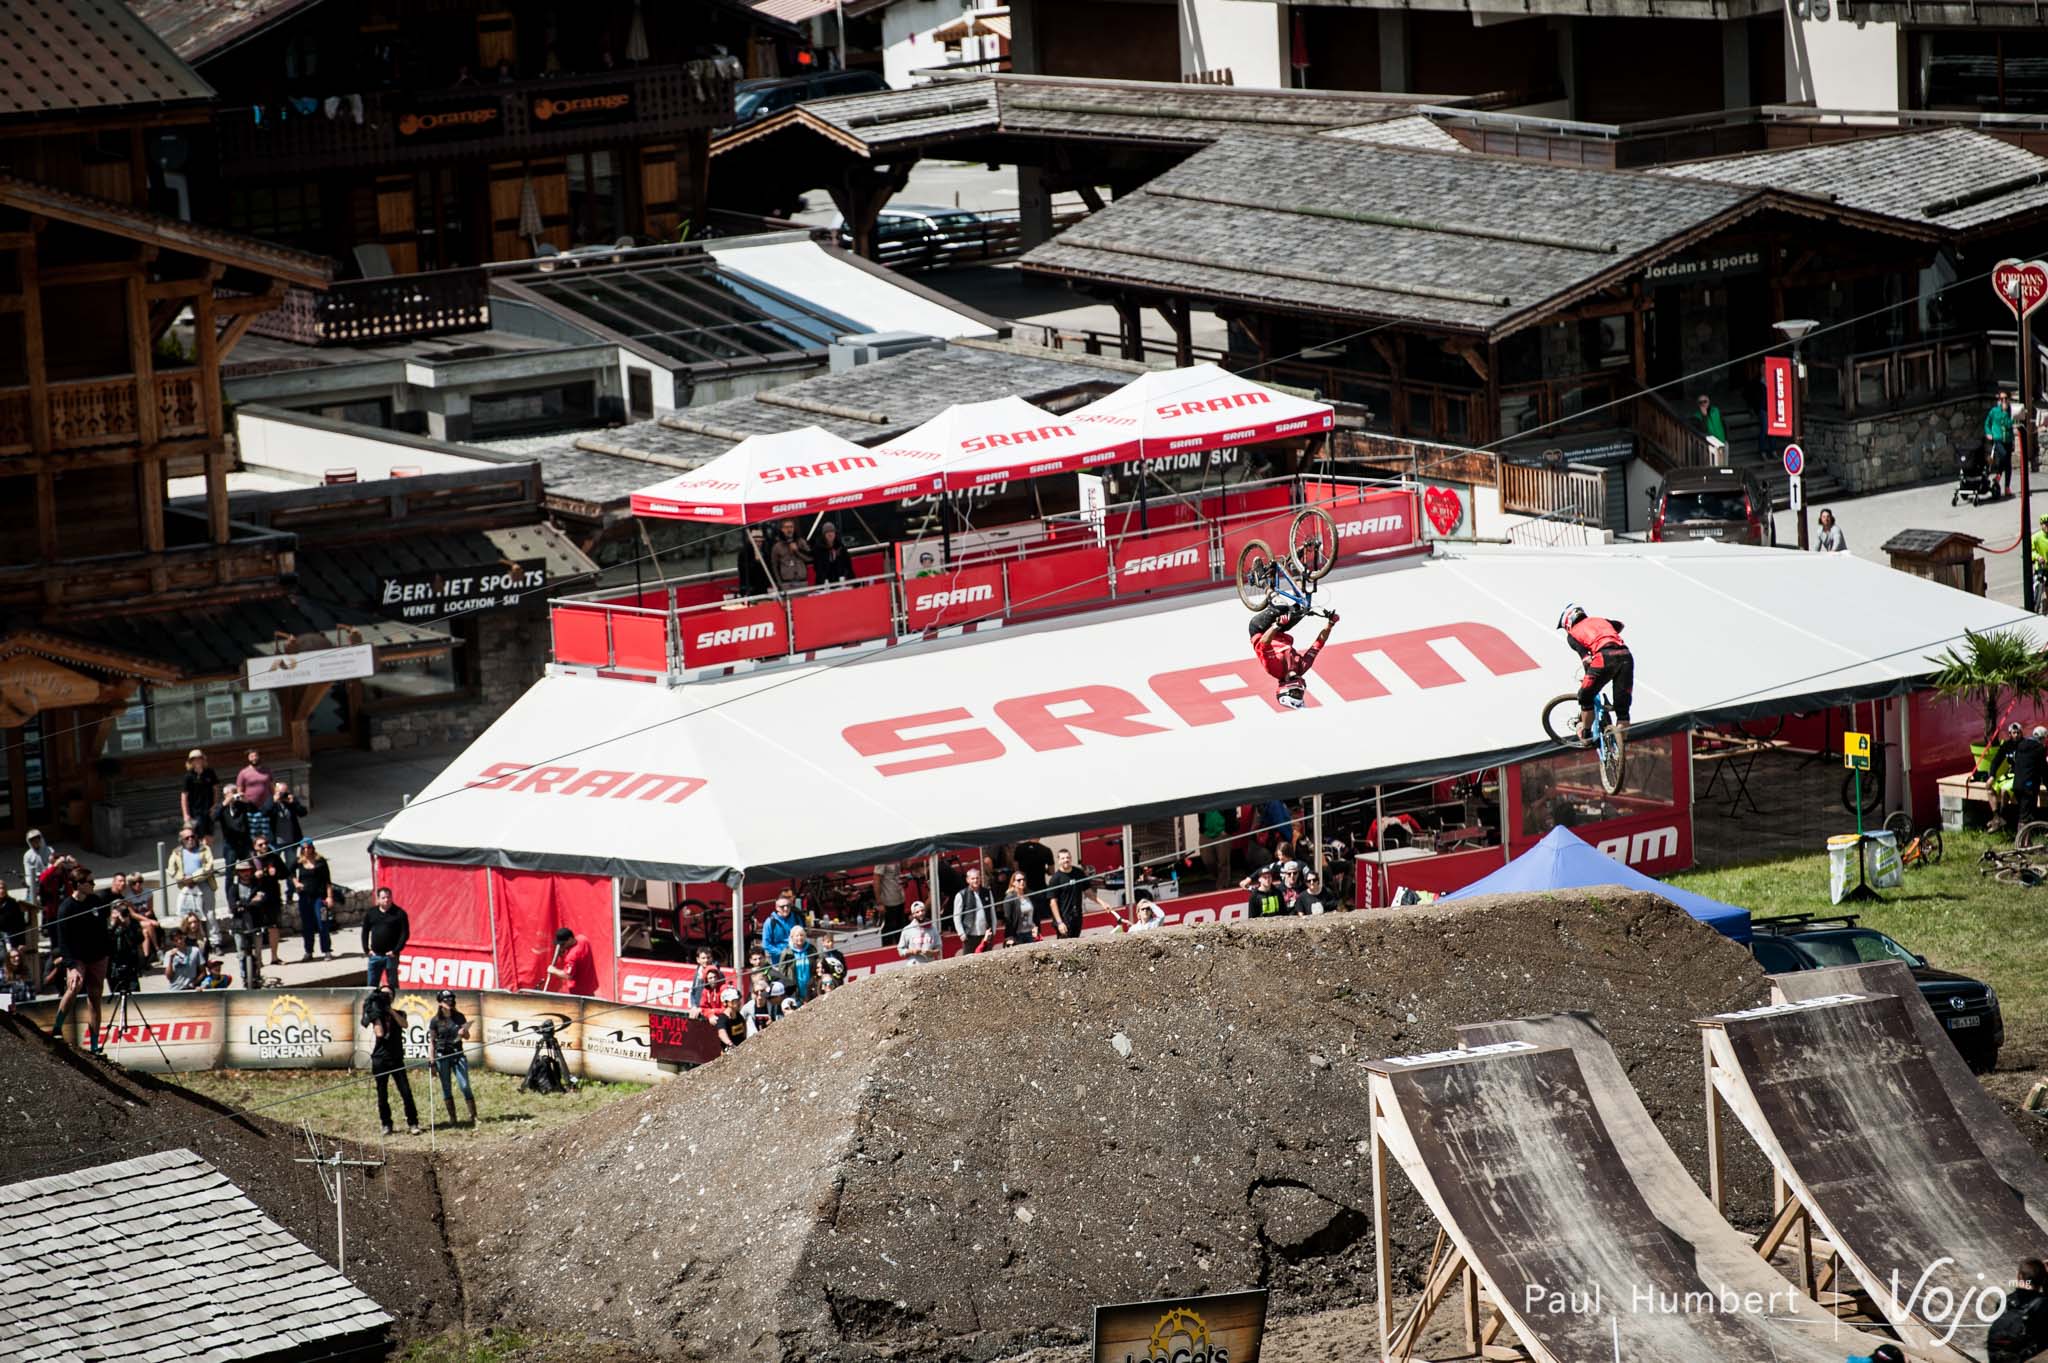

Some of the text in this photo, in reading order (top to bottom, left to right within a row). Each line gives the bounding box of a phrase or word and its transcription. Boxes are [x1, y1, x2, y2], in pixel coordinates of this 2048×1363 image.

[553, 95, 629, 113] Orange
[419, 108, 497, 129] Orange
[1712, 253, 1759, 271] sports
[1156, 391, 1271, 420] SRAM
[1072, 414, 1136, 426] SRAM
[1275, 420, 1308, 432] SRAM
[960, 424, 1076, 453] SRAM
[1169, 438, 1203, 449] SRAM
[1222, 429, 1256, 441] SRAM
[1082, 451, 1116, 464] SRAM
[1210, 447, 1238, 465] SKI
[759, 456, 878, 484] SRAM
[975, 470, 1009, 482] SRAM
[1029, 461, 1062, 474] SRAM
[883, 483, 917, 496] SRAM
[772, 501, 807, 513] SRAM
[828, 493, 863, 505] SRAM
[1124, 548, 1199, 576] SRAM
[403, 594, 520, 617] VENTE LOCATION SKI
[915, 584, 993, 611] SRAM
[696, 621, 775, 650] SRAM
[842, 621, 1541, 777] SRAM
[464, 762, 707, 804] SRAM
[1596, 826, 1678, 864] AM
[621, 974, 694, 1008] SRA
[83, 1021, 212, 1046] SRAM
[249, 1025, 332, 1045] Les Gets
[650, 1030, 682, 1046] +0.22
[260, 1044, 324, 1059] BIKEPARK
